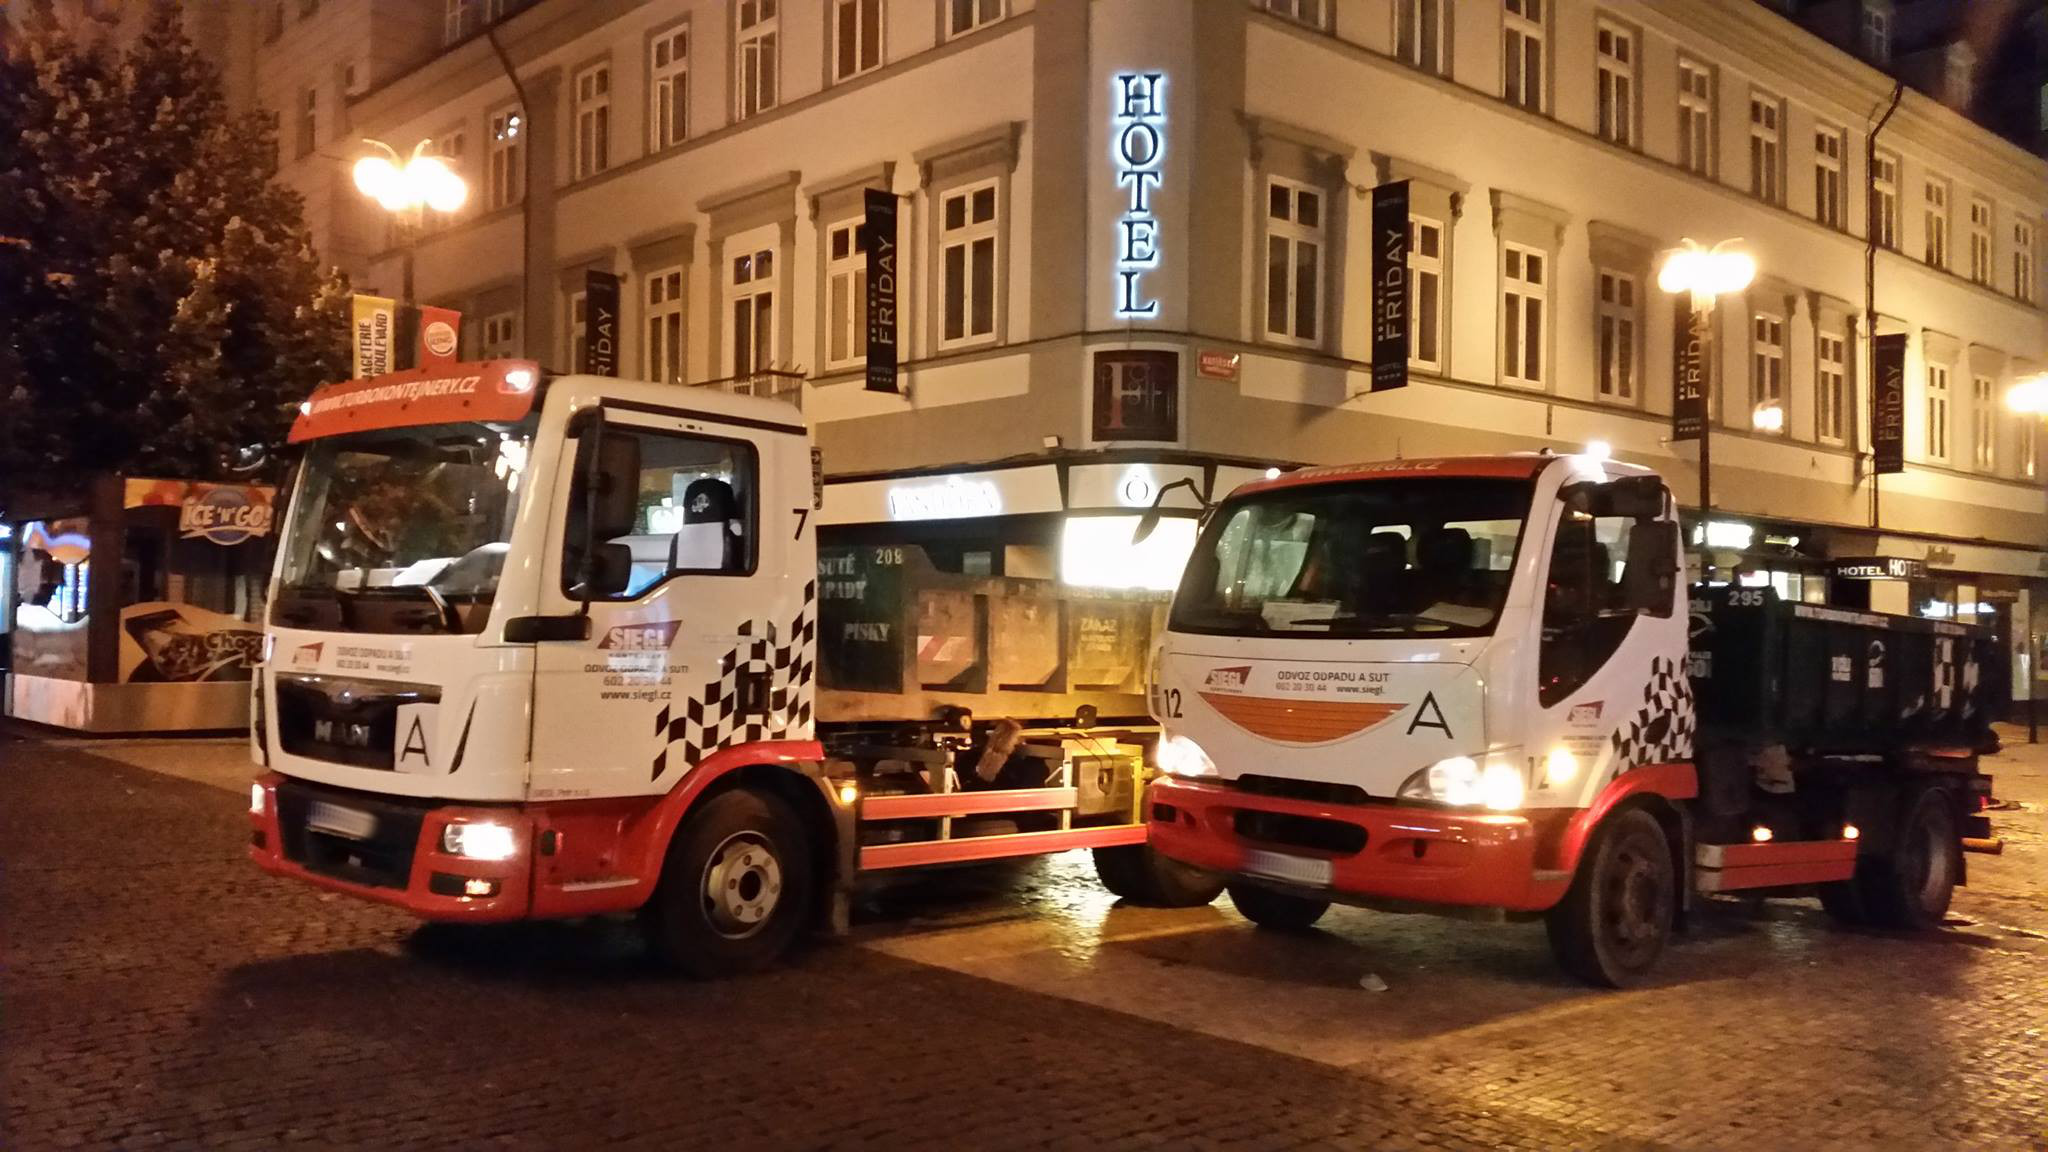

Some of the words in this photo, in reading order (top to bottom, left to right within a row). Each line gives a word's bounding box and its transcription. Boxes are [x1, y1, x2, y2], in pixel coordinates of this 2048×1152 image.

[1118, 73, 1162, 313] HOTEL
[878, 235, 894, 345] FRIDAY
[1386, 229, 1402, 340] FRIDAY
[1886, 366, 1901, 440] FRIDAY
[792, 508, 809, 541] 7
[876, 549, 903, 565] 208
[1838, 566, 1885, 576] HOTEL
[1889, 559, 1928, 578] HOTEL
[1728, 591, 1764, 606] 295
[608, 627, 668, 651] SIEGL
[1278, 671, 1311, 681] ODVOZ
[1313, 671, 1355, 682] ODPADU
[1358, 673, 1367, 682] A
[600, 690, 672, 702] www.siegl.cz
[1164, 688, 1183, 718] 12
[1406, 690, 1454, 740] A
[400, 713, 430, 767] A
